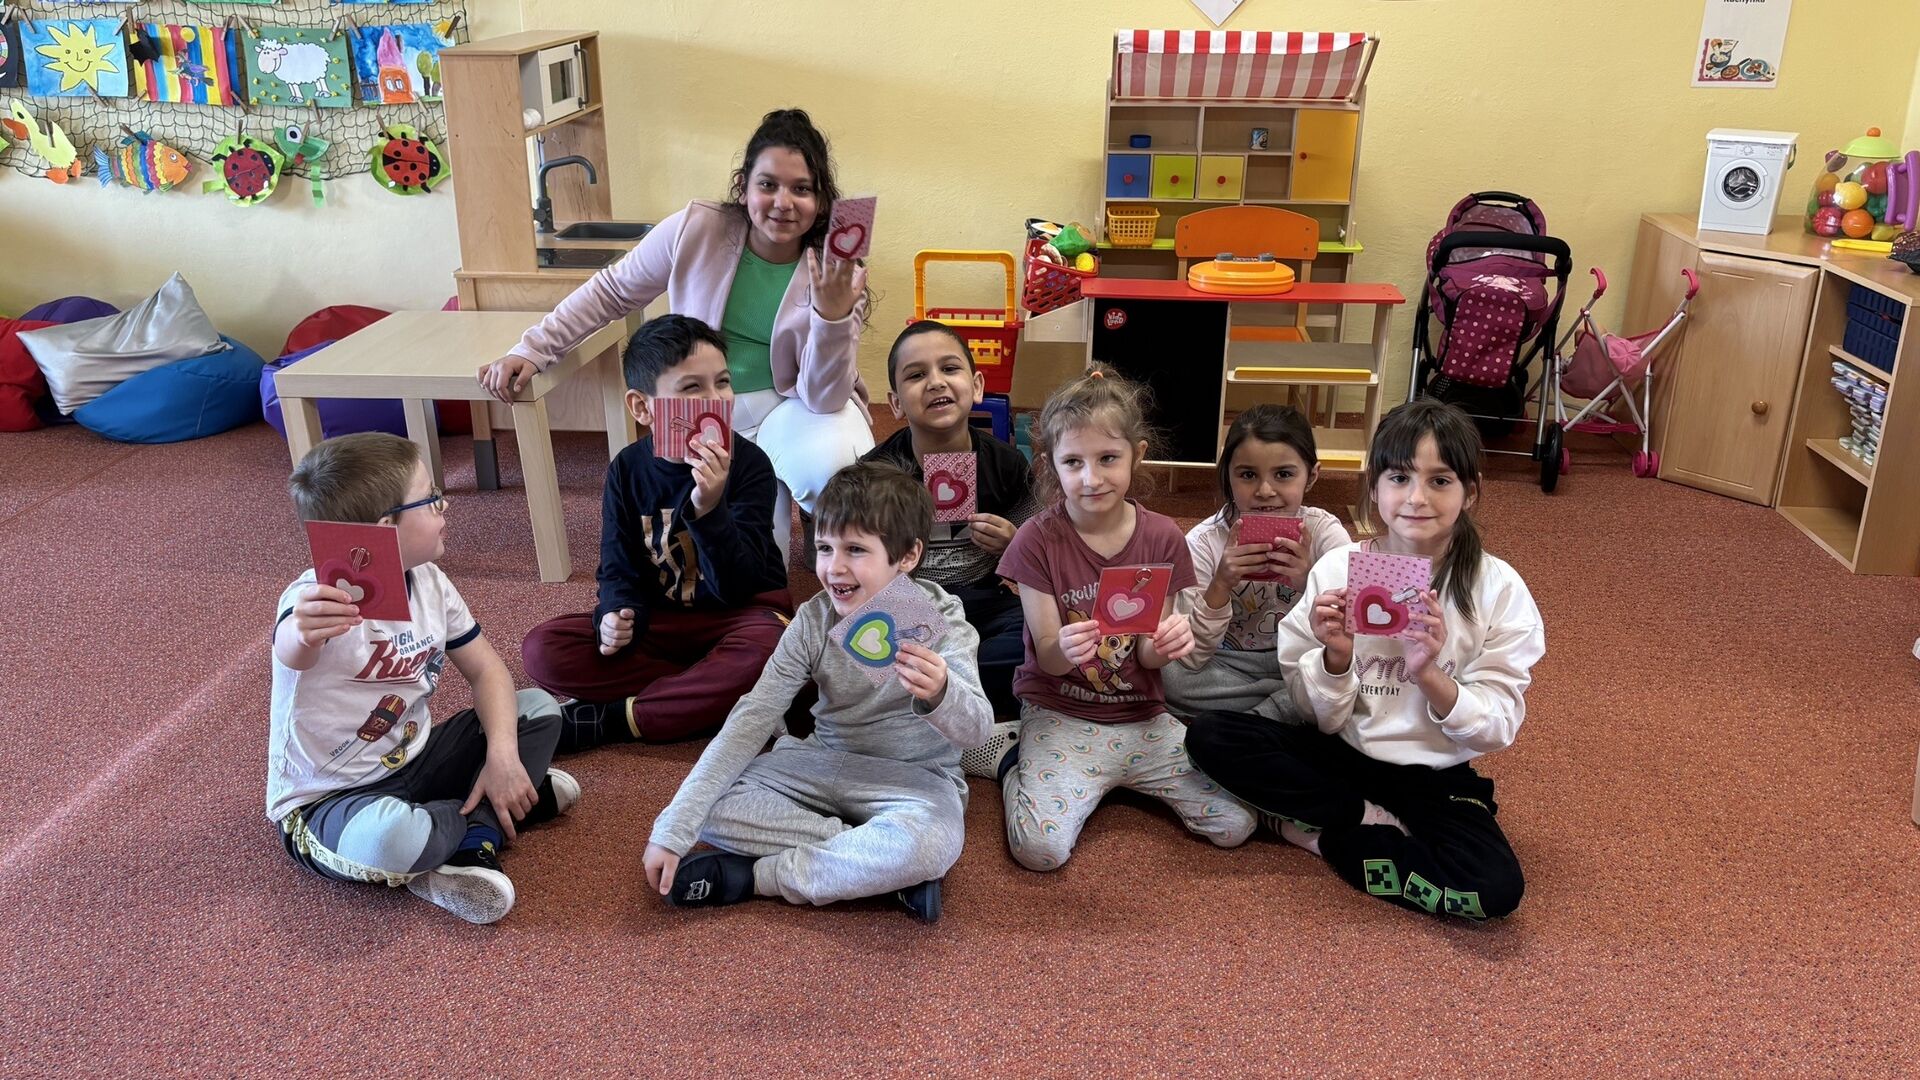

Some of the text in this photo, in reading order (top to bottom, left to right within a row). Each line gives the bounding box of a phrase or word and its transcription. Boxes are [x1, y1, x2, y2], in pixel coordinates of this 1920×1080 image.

[1060, 682, 1096, 702] PAW
[1361, 684, 1400, 696] EVERY DAY
